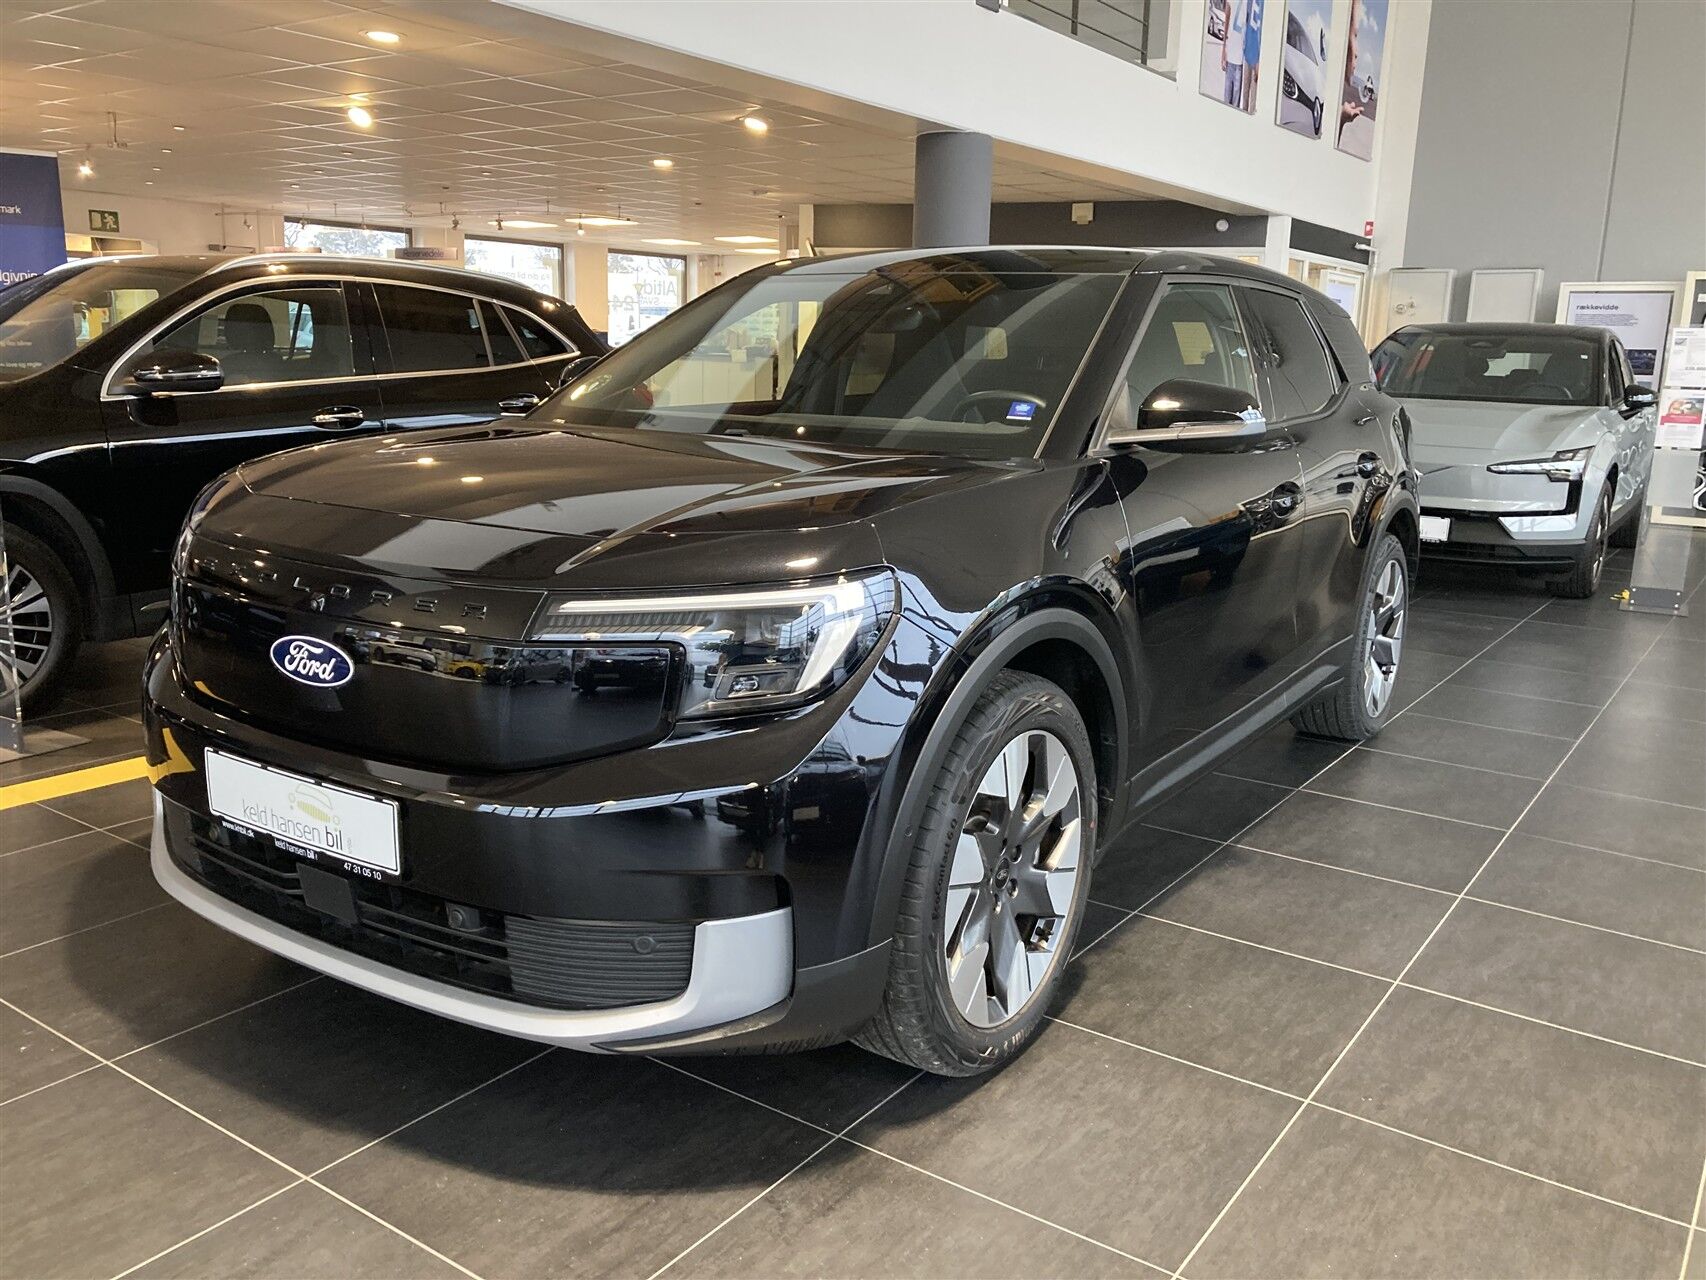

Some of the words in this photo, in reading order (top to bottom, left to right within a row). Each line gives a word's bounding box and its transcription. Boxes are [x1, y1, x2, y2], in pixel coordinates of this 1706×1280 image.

[1576, 303, 1619, 311] rækkevidde
[284, 640, 337, 681] Ford
[241, 798, 268, 827] keld
[270, 808, 322, 845] hansen
[325, 826, 343, 851] bil
[274, 838, 287, 850] keld
[287, 843, 306, 857] hansen
[306, 850, 315, 860] bil
[343, 861, 352, 871] 47
[353, 864, 361, 875] 31
[362, 867, 372, 878] 05
[373, 870, 382, 881] 10
